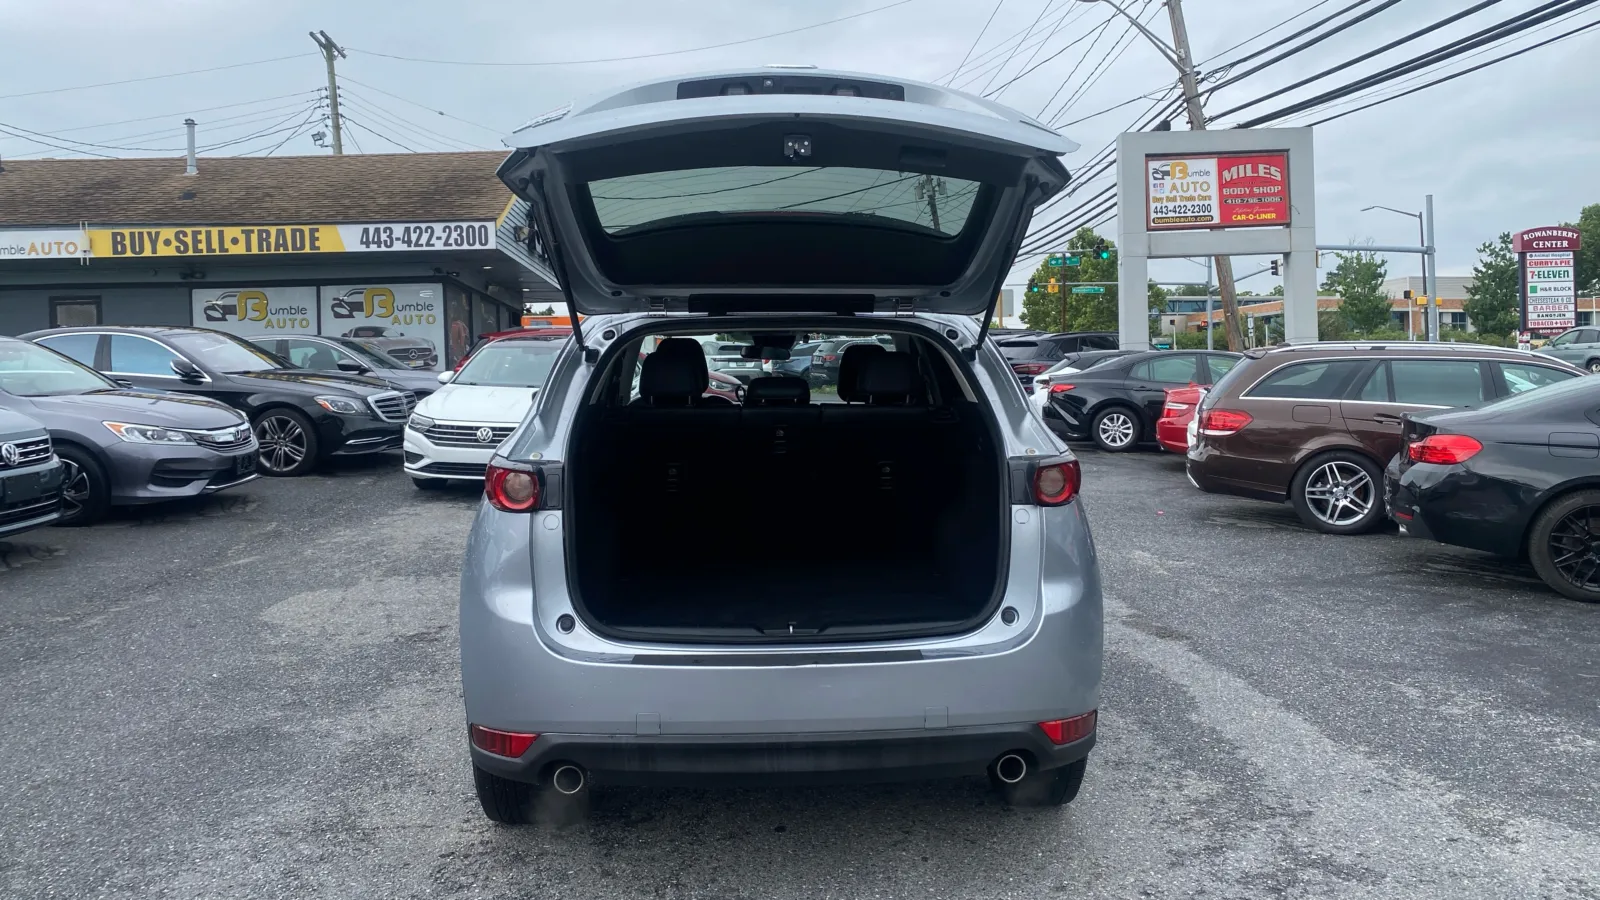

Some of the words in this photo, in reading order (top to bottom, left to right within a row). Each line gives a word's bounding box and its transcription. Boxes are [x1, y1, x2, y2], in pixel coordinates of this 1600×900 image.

[1170, 161, 1211, 180] Bumble
[1222, 163, 1282, 184] MILES
[1170, 181, 1211, 194] AUTO
[1223, 187, 1251, 195] BODY
[1253, 185, 1281, 194] SHOP
[1178, 194, 1196, 202] Trade
[1197, 193, 1212, 201] Cars
[1153, 203, 1212, 215] 443-422-2300
[1154, 215, 1212, 223] bumbleauto.com
[1232, 213, 1276, 221] CAR-O-LINER
[359, 224, 489, 249] 443-422-2300
[1523, 230, 1579, 240] ROWANBERRY
[27, 241, 79, 256] AUTO
[1532, 240, 1569, 248] CENTER
[237, 290, 308, 321] Bumble
[363, 287, 434, 319] Bumble
[264, 316, 310, 329] AUTO
[391, 314, 437, 326] AUTO
